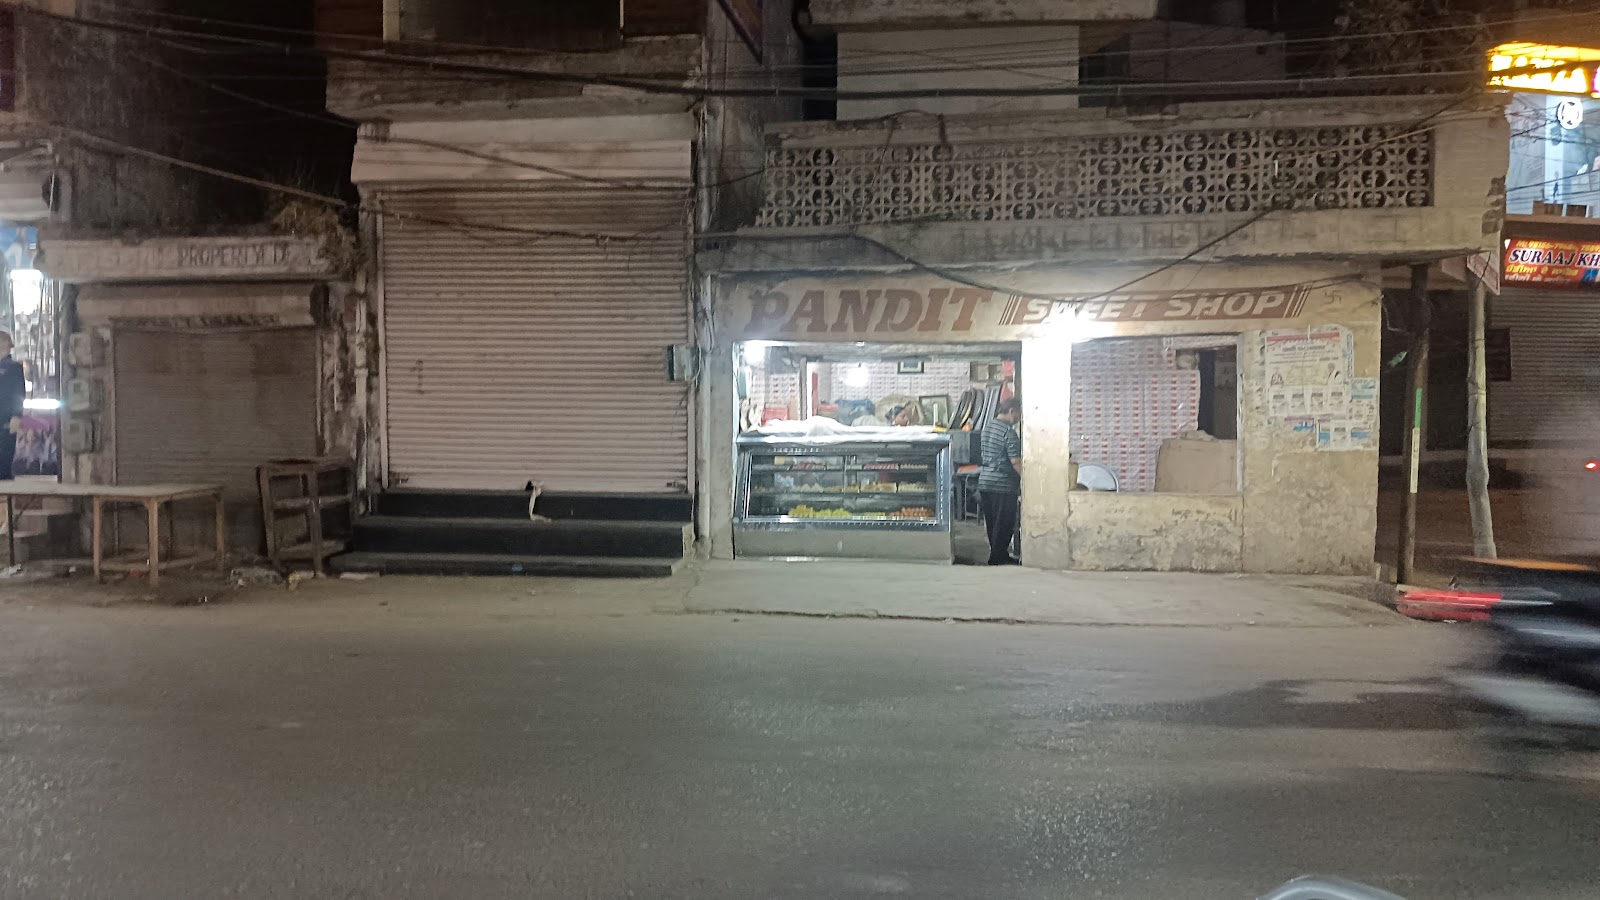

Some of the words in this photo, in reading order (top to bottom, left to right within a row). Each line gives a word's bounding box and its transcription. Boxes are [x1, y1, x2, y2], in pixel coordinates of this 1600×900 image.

[1510, 249, 1576, 264] SURAAJ
[1577, 254, 1600, 266] KH
[744, 287, 994, 333] PANDIT
[1023, 294, 1161, 322] SWEET
[1163, 291, 1285, 317] SHOP
